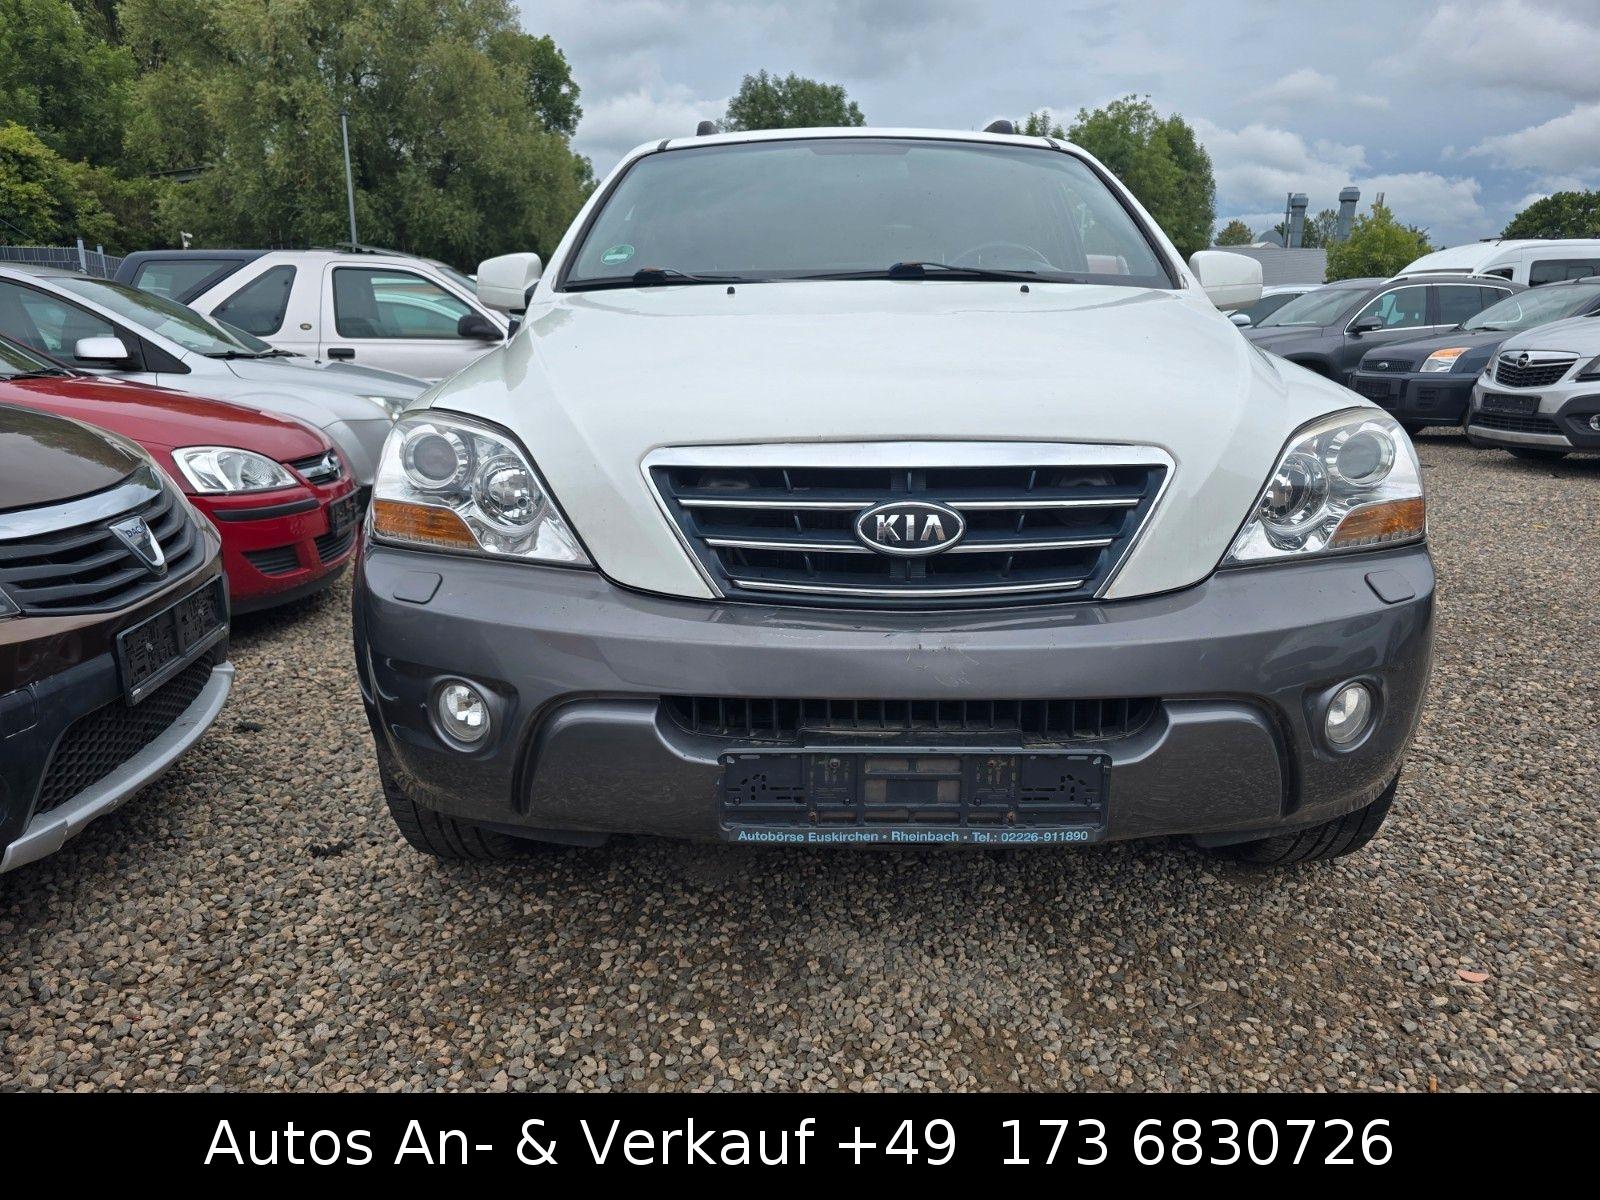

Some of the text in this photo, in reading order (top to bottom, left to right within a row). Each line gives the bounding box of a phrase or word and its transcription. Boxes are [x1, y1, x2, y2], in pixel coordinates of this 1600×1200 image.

[875, 514, 946, 541] KIA
[738, 830, 804, 842] Autobörse
[808, 830, 878, 842] Euskirchen
[891, 830, 959, 842] Rheinbach
[1001, 830, 1088, 843] 02226-911890
